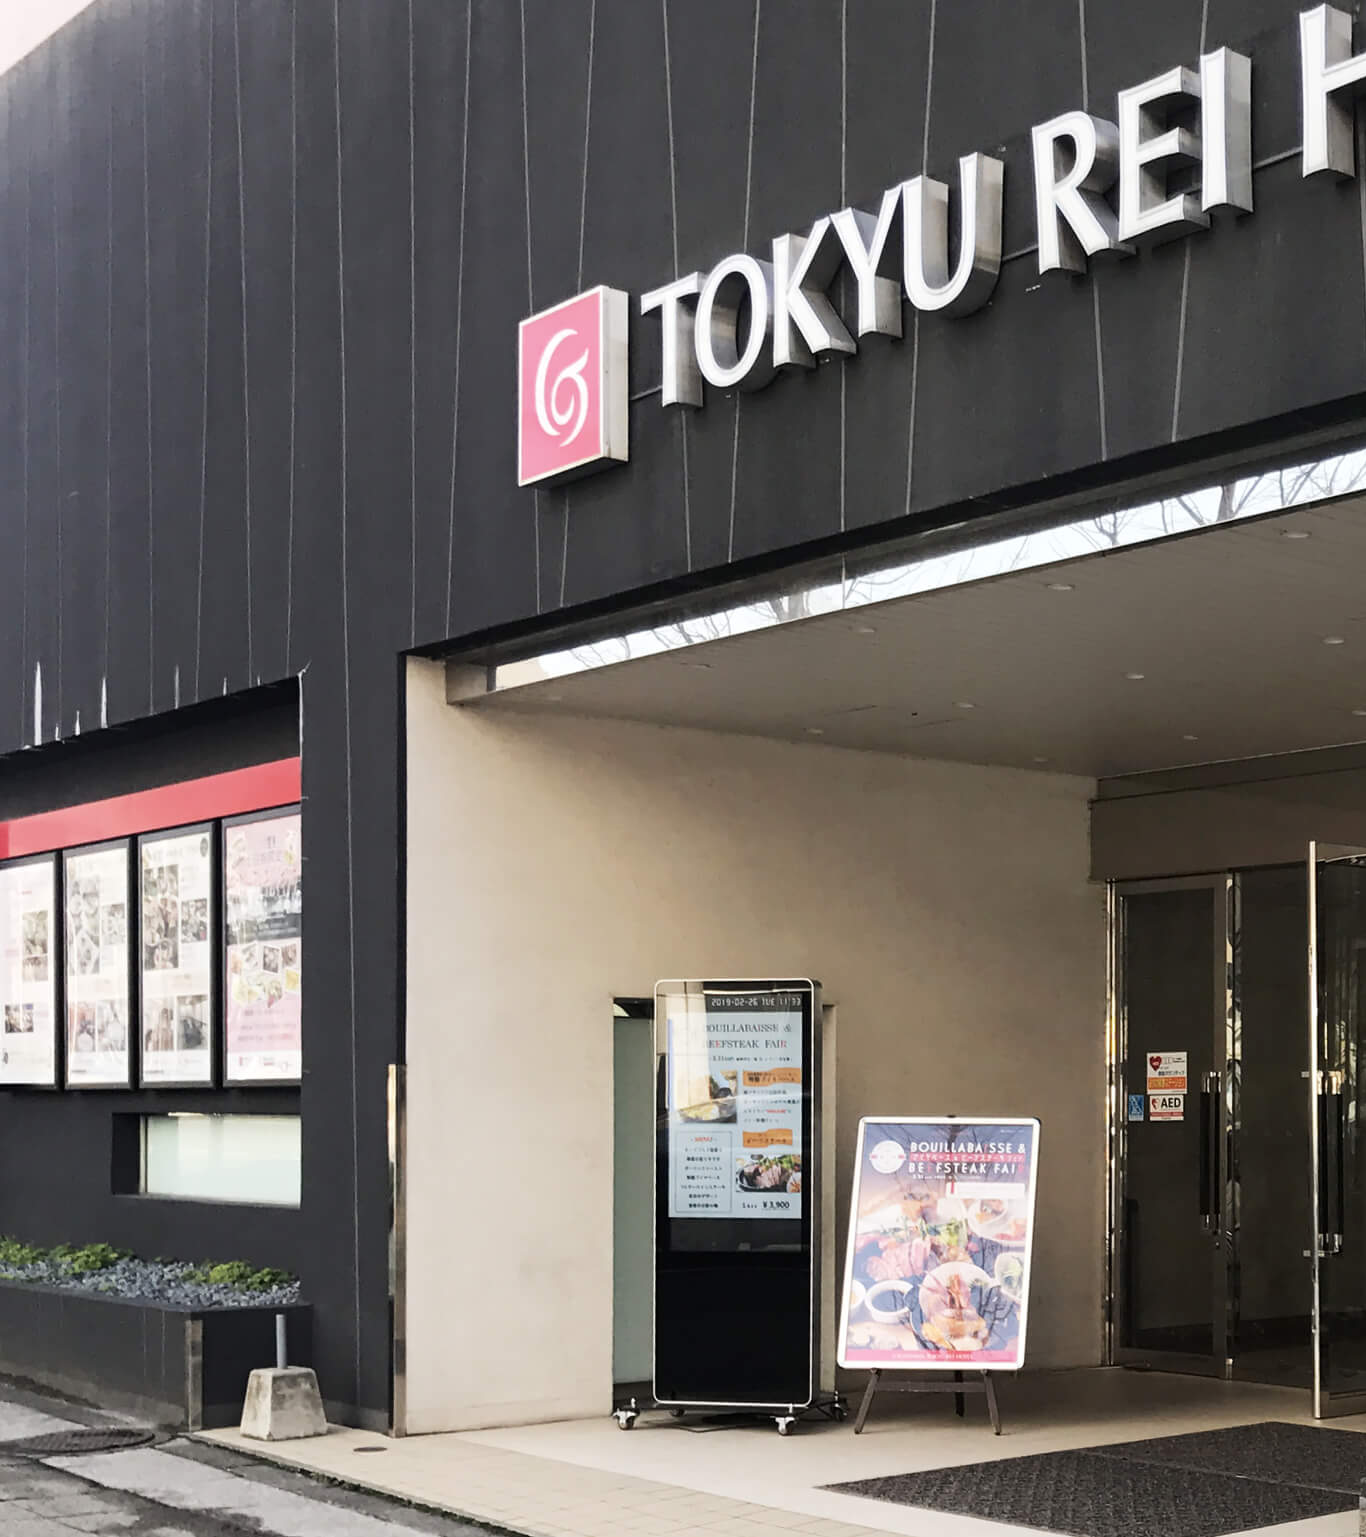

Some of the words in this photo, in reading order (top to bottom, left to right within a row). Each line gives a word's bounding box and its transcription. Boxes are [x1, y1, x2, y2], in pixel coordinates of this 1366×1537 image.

[640, 152, 1004, 408] TOKYU
[1032, 46, 1253, 276] REI
[711, 998, 758, 1007] 2019-02-26
[706, 1023, 779, 1033] OUILLABAISSE
[708, 1040, 760, 1049] EEFSTEAK
[765, 1040, 788, 1049] FAIR
[1160, 1096, 1182, 1108] AED
[910, 1142, 1013, 1154] BOUILLABAISSE
[1018, 1143, 1027, 1154] &
[908, 1162, 987, 1174] BEEFSTEAK
[994, 1164, 1024, 1175] FAIR
